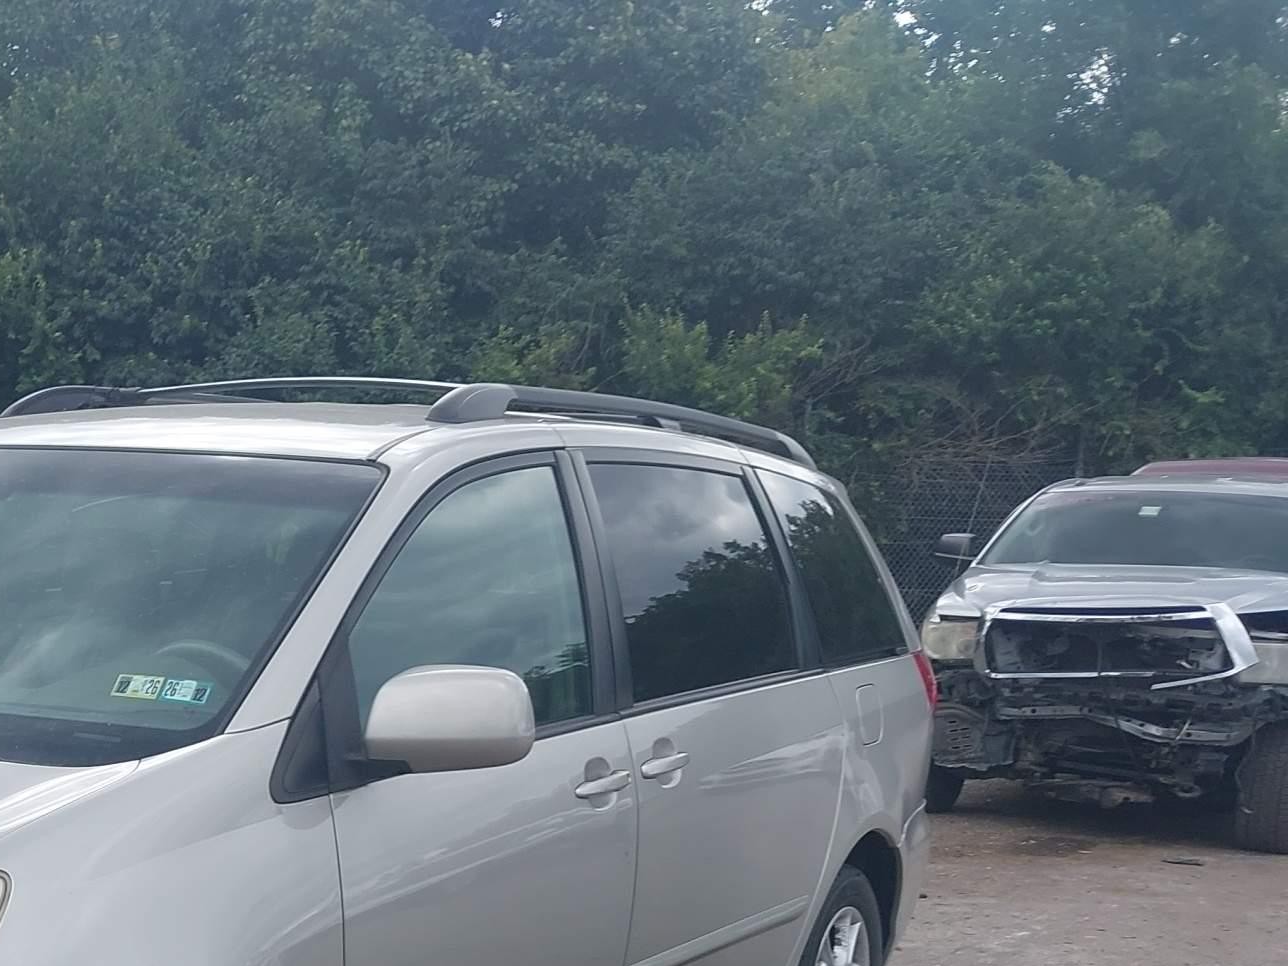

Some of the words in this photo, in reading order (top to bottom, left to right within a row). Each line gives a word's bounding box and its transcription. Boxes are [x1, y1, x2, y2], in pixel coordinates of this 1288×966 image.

[145, 679, 161, 695] 26
[164, 681, 180, 697] 26
[192, 688, 208, 702] 12
